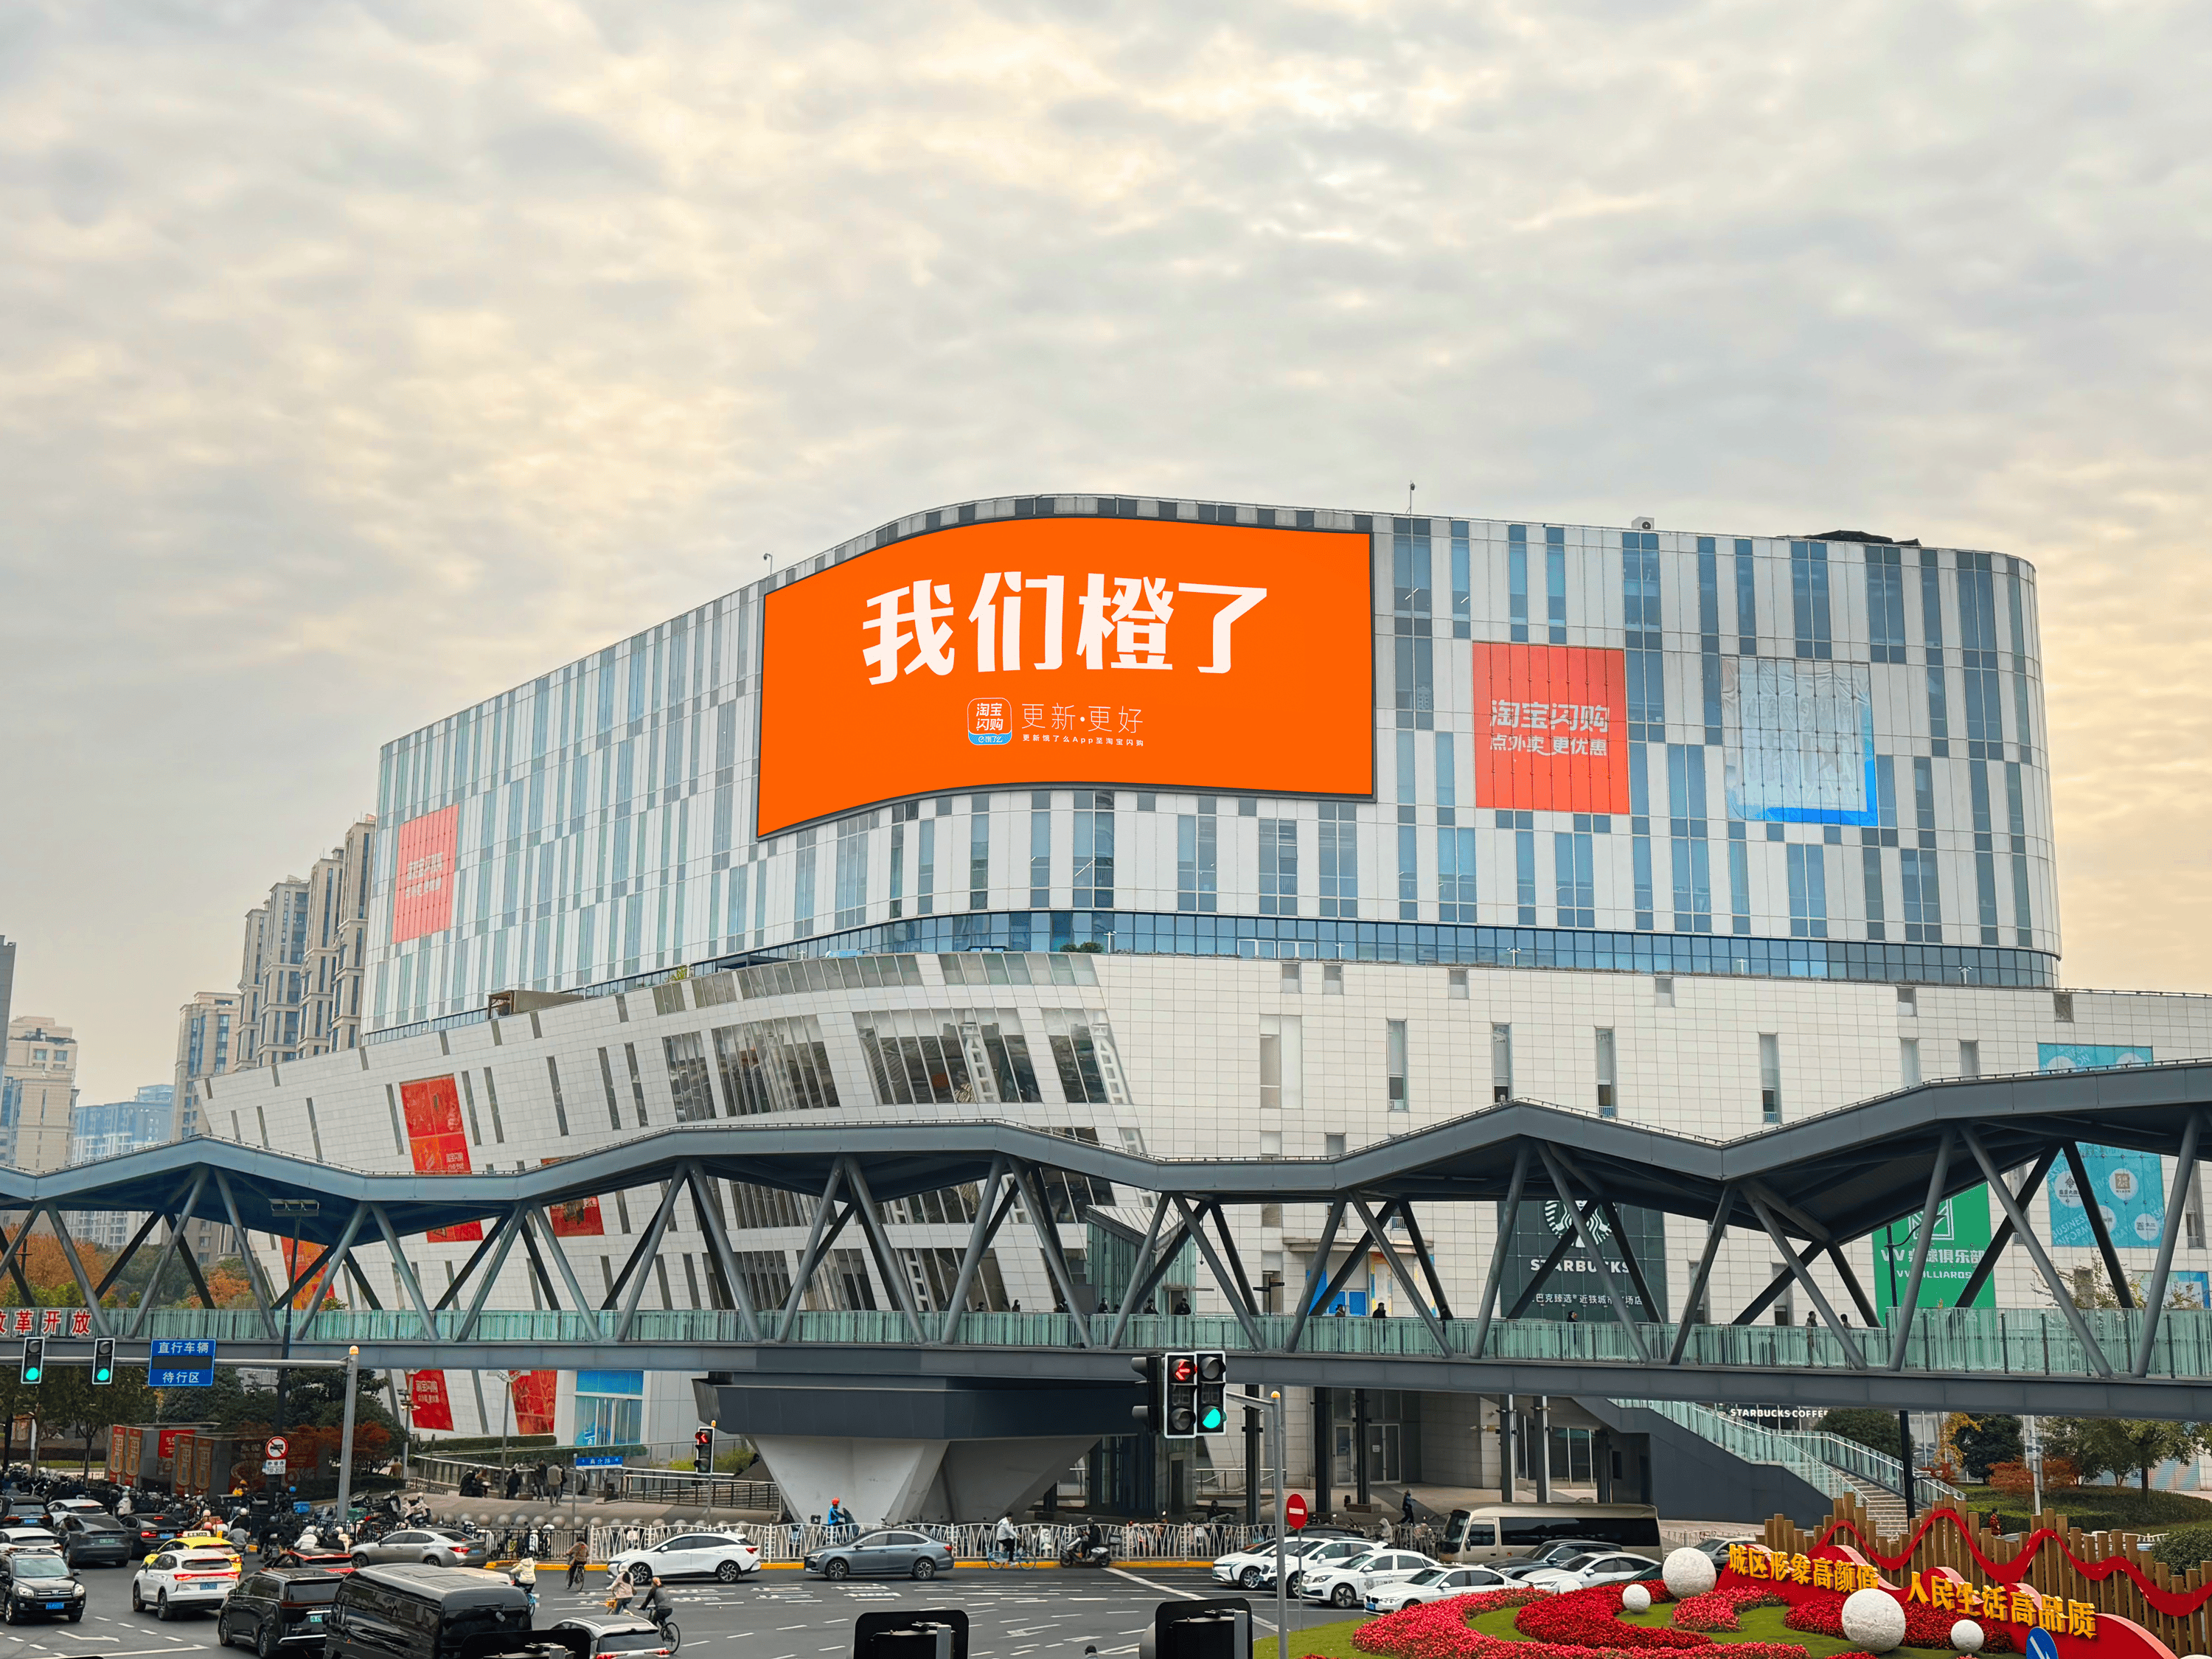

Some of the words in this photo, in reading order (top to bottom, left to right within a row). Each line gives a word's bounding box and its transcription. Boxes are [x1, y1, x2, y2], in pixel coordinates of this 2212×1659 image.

[862, 571, 1267, 686] 我们橙了
[975, 702, 1003, 717] 淘宝
[1489, 699, 1610, 733] 淘宝闪购
[975, 717, 1004, 731] 闪购
[1022, 734, 1144, 747] 更新饿了么App至淘宝闪购
[1923, 1270, 1972, 1279] ILLIARDS
[158, 1341, 209, 1354] 直行车辆
[162, 1371, 200, 1383] 待行区
[1731, 1408, 1790, 1418] STARBUCKS
[1729, 1544, 1879, 1593] 城区形象高颜值
[1907, 1572, 2097, 1638] 人民生活高品质
